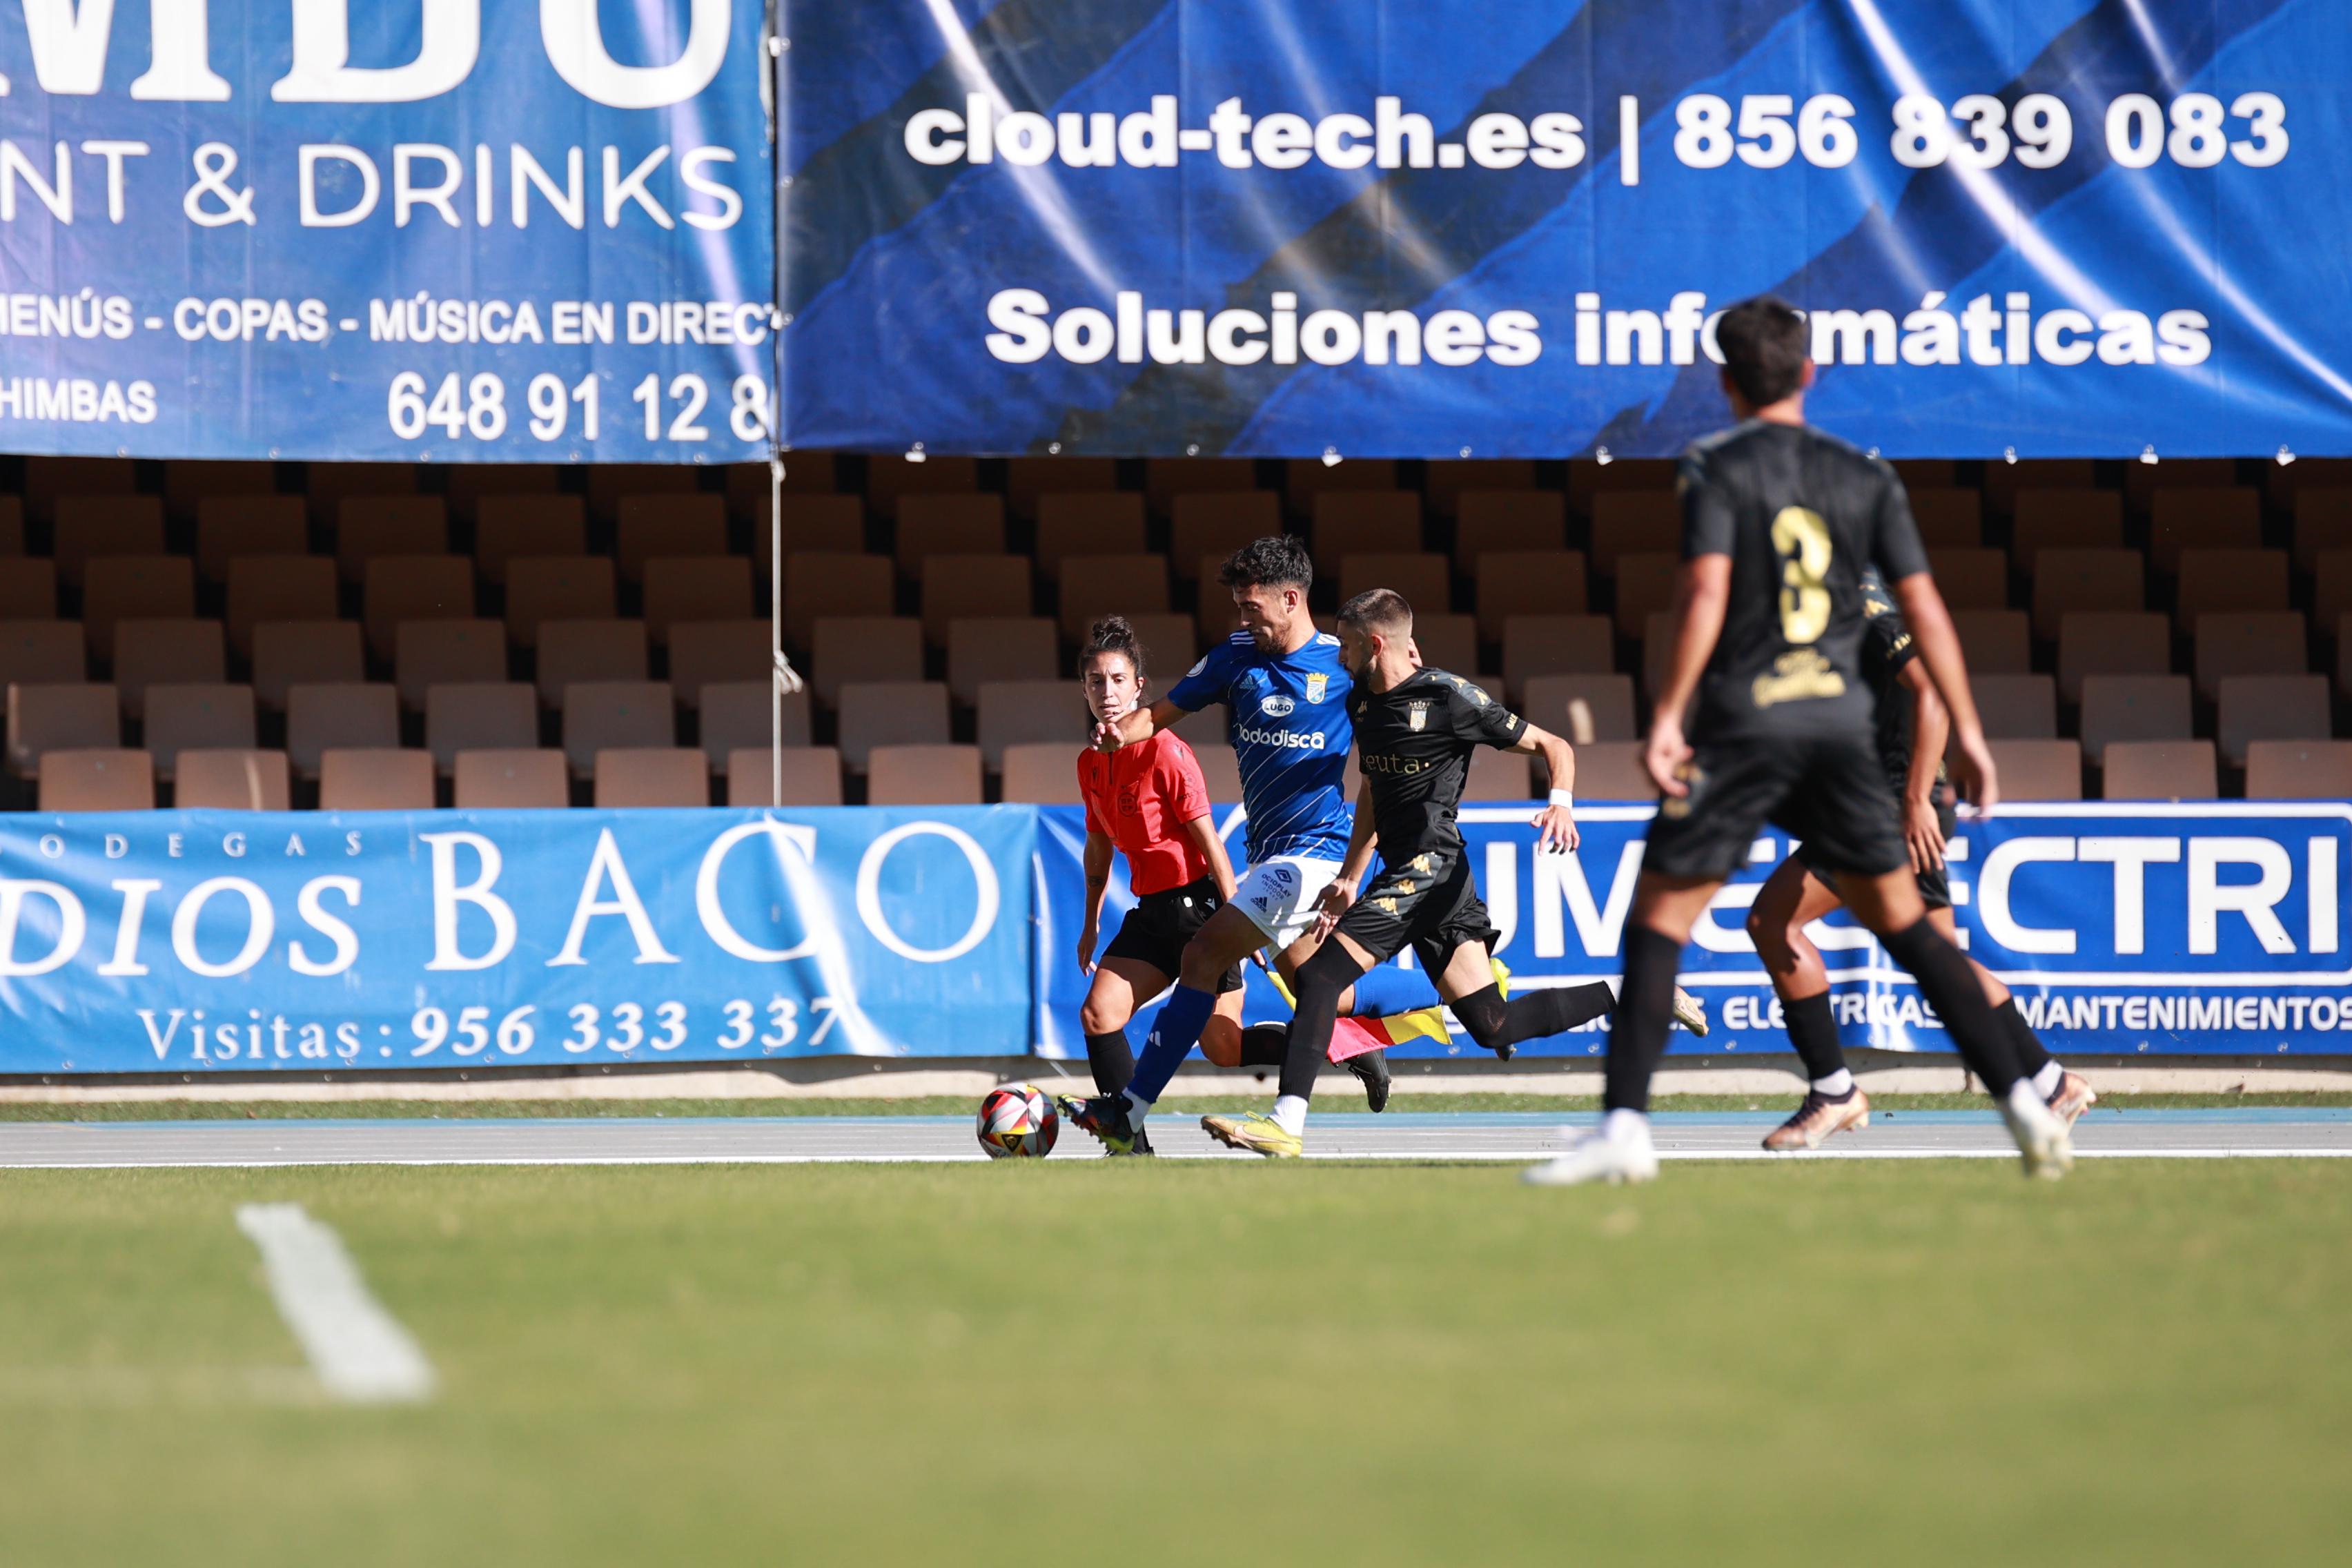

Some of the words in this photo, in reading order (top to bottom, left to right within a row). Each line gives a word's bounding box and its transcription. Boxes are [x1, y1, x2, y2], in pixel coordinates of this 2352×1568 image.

[904, 92, 1585, 169] cloud-tech.es
[1673, 93, 1859, 169] 856
[1890, 93, 2073, 169] 839
[2104, 92, 2290, 169] 083
[0, 140, 150, 226] NT
[183, 141, 257, 227] &
[298, 143, 743, 231] DRINKS
[173, 297, 329, 342] COPAS
[369, 291, 544, 344] MÚSICA
[552, 302, 614, 344] EN
[627, 301, 776, 346] DIREC
[985, 288, 1542, 366] Soluciones
[1574, 292, 2212, 366] infmáticas
[388, 371, 507, 441] 648
[527, 373, 599, 442] 91
[632, 373, 709, 442] 12
[1771, 505, 1832, 645] 3
[1264, 703, 1291, 712] LUGO
[419, 821, 1000, 970] BACO
[411, 1004, 536, 1057] 956
[562, 1001, 687, 1053] 333
[717, 998, 841, 1050] 337
